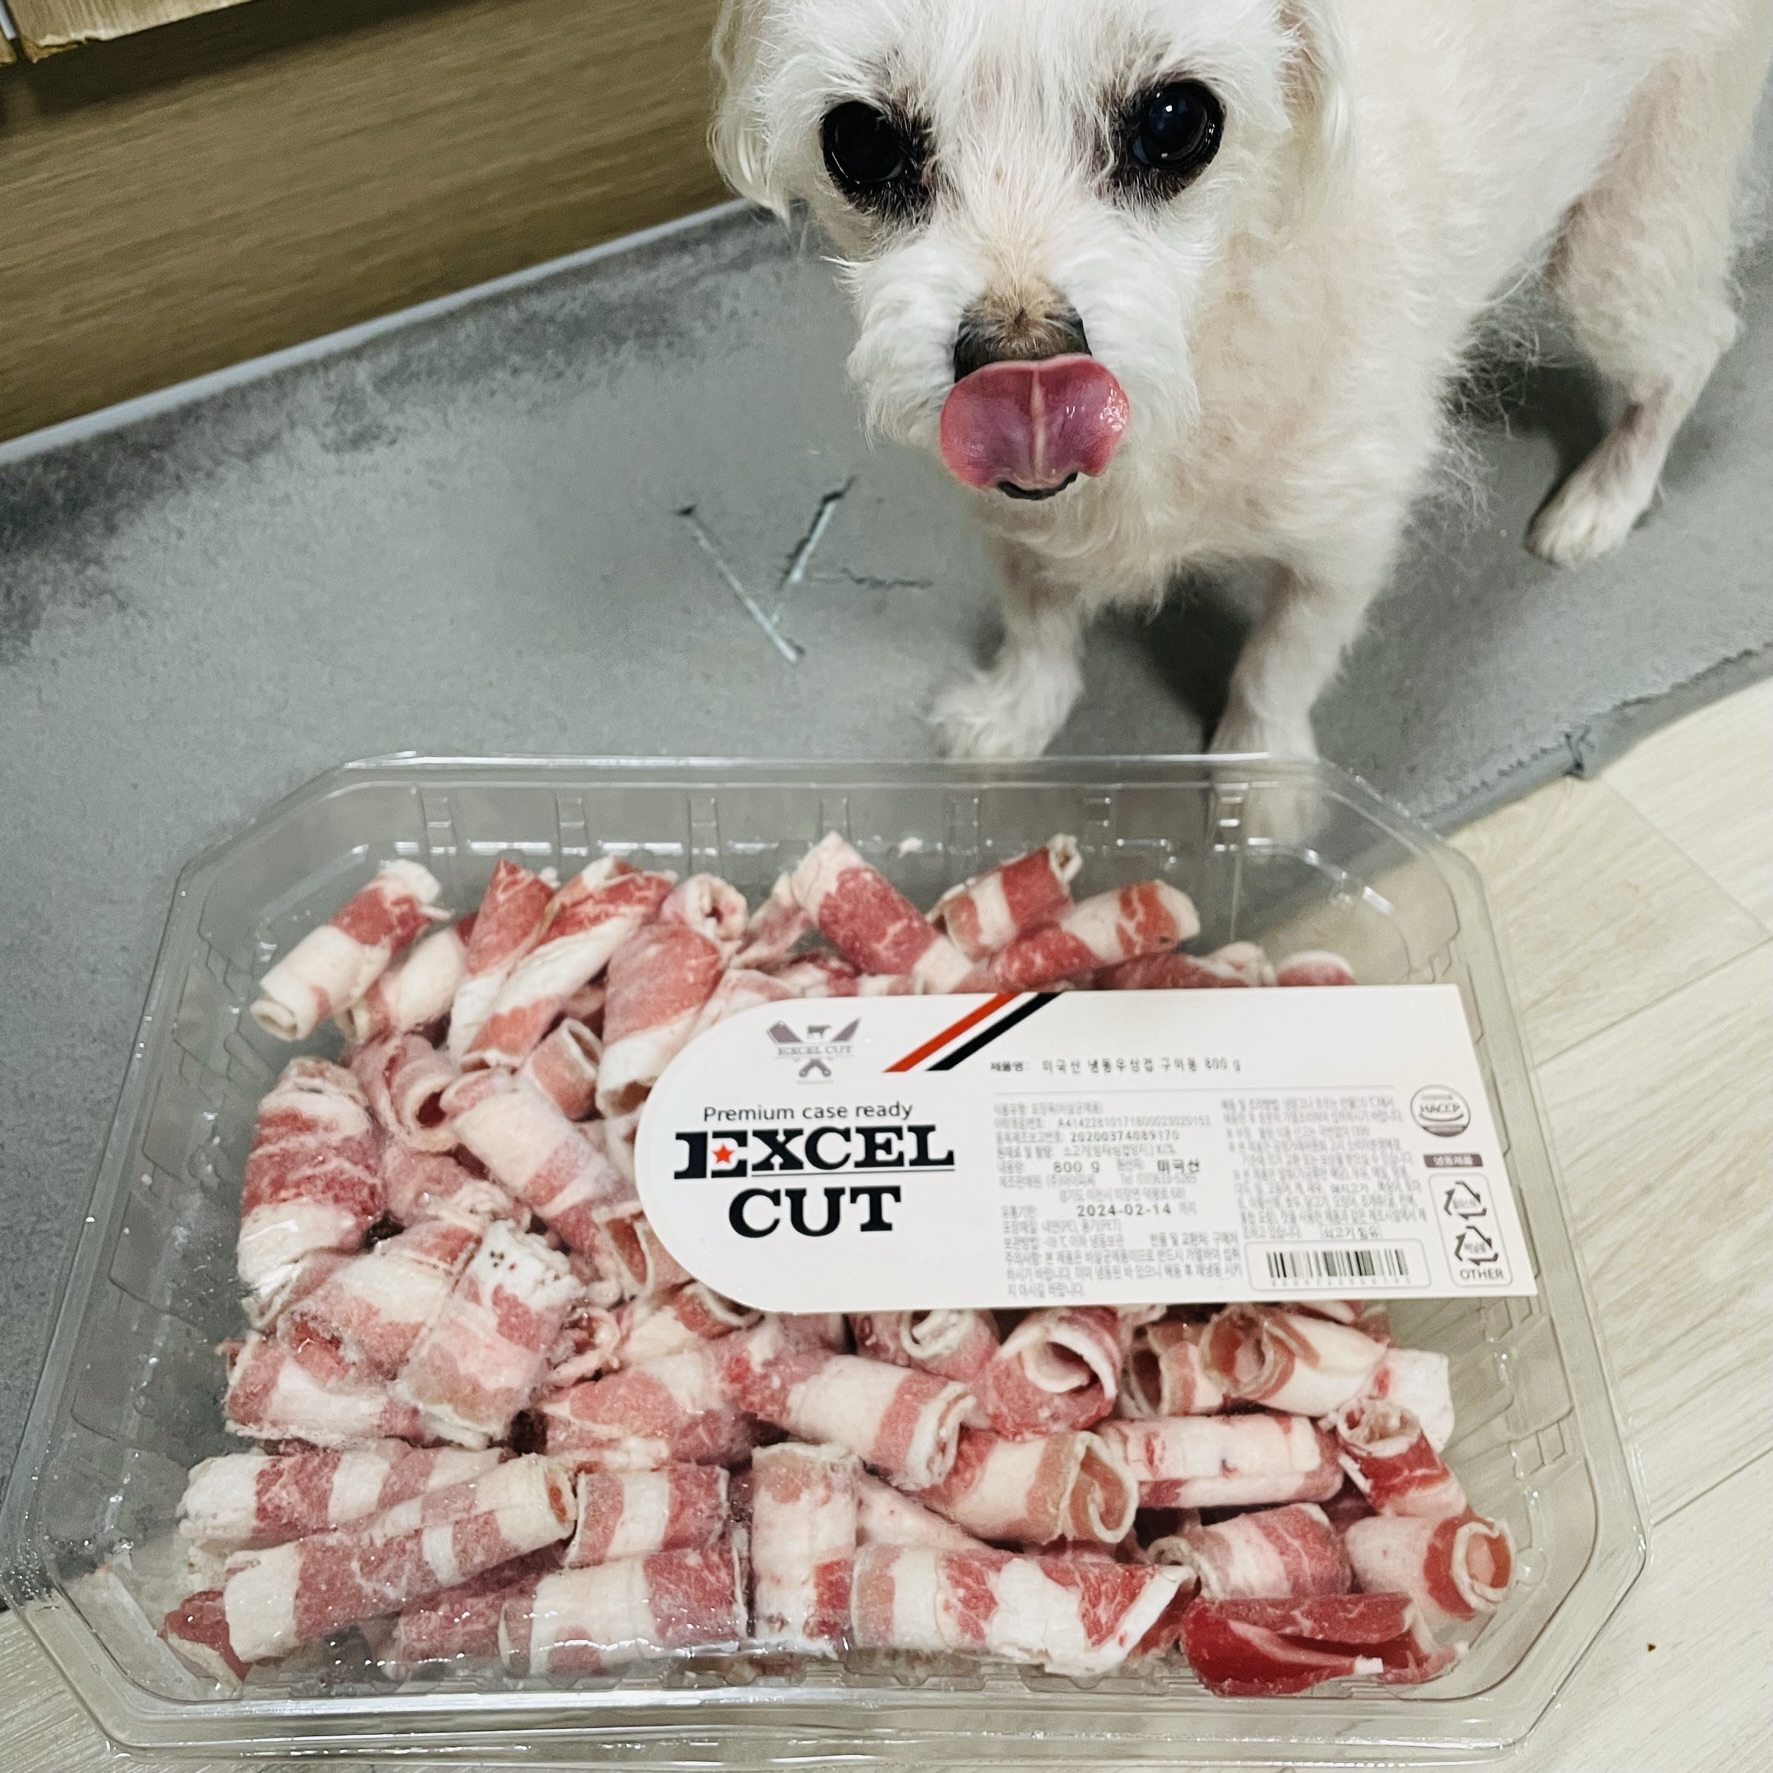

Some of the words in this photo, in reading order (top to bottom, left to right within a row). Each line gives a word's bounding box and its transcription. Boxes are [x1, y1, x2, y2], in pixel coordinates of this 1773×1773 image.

[777, 1046, 822, 1056] EXCEL
[825, 1045, 854, 1055] CUT
[1204, 1057, 1228, 1070] 800
[703, 1104, 795, 1122] Premium
[802, 1105, 848, 1120] case
[855, 1100, 913, 1120] ready
[1419, 1103, 1460, 1113] HACCP
[673, 1124, 956, 1179] EXCEL
[1053, 1160, 1082, 1173] 800
[1091, 1160, 1100, 1174] g
[1157, 1157, 1200, 1174] 미국산
[728, 1185, 902, 1239] CUT
[1076, 1203, 1171, 1217] 2024-02-14
[1460, 1268, 1504, 1280] OTHER
